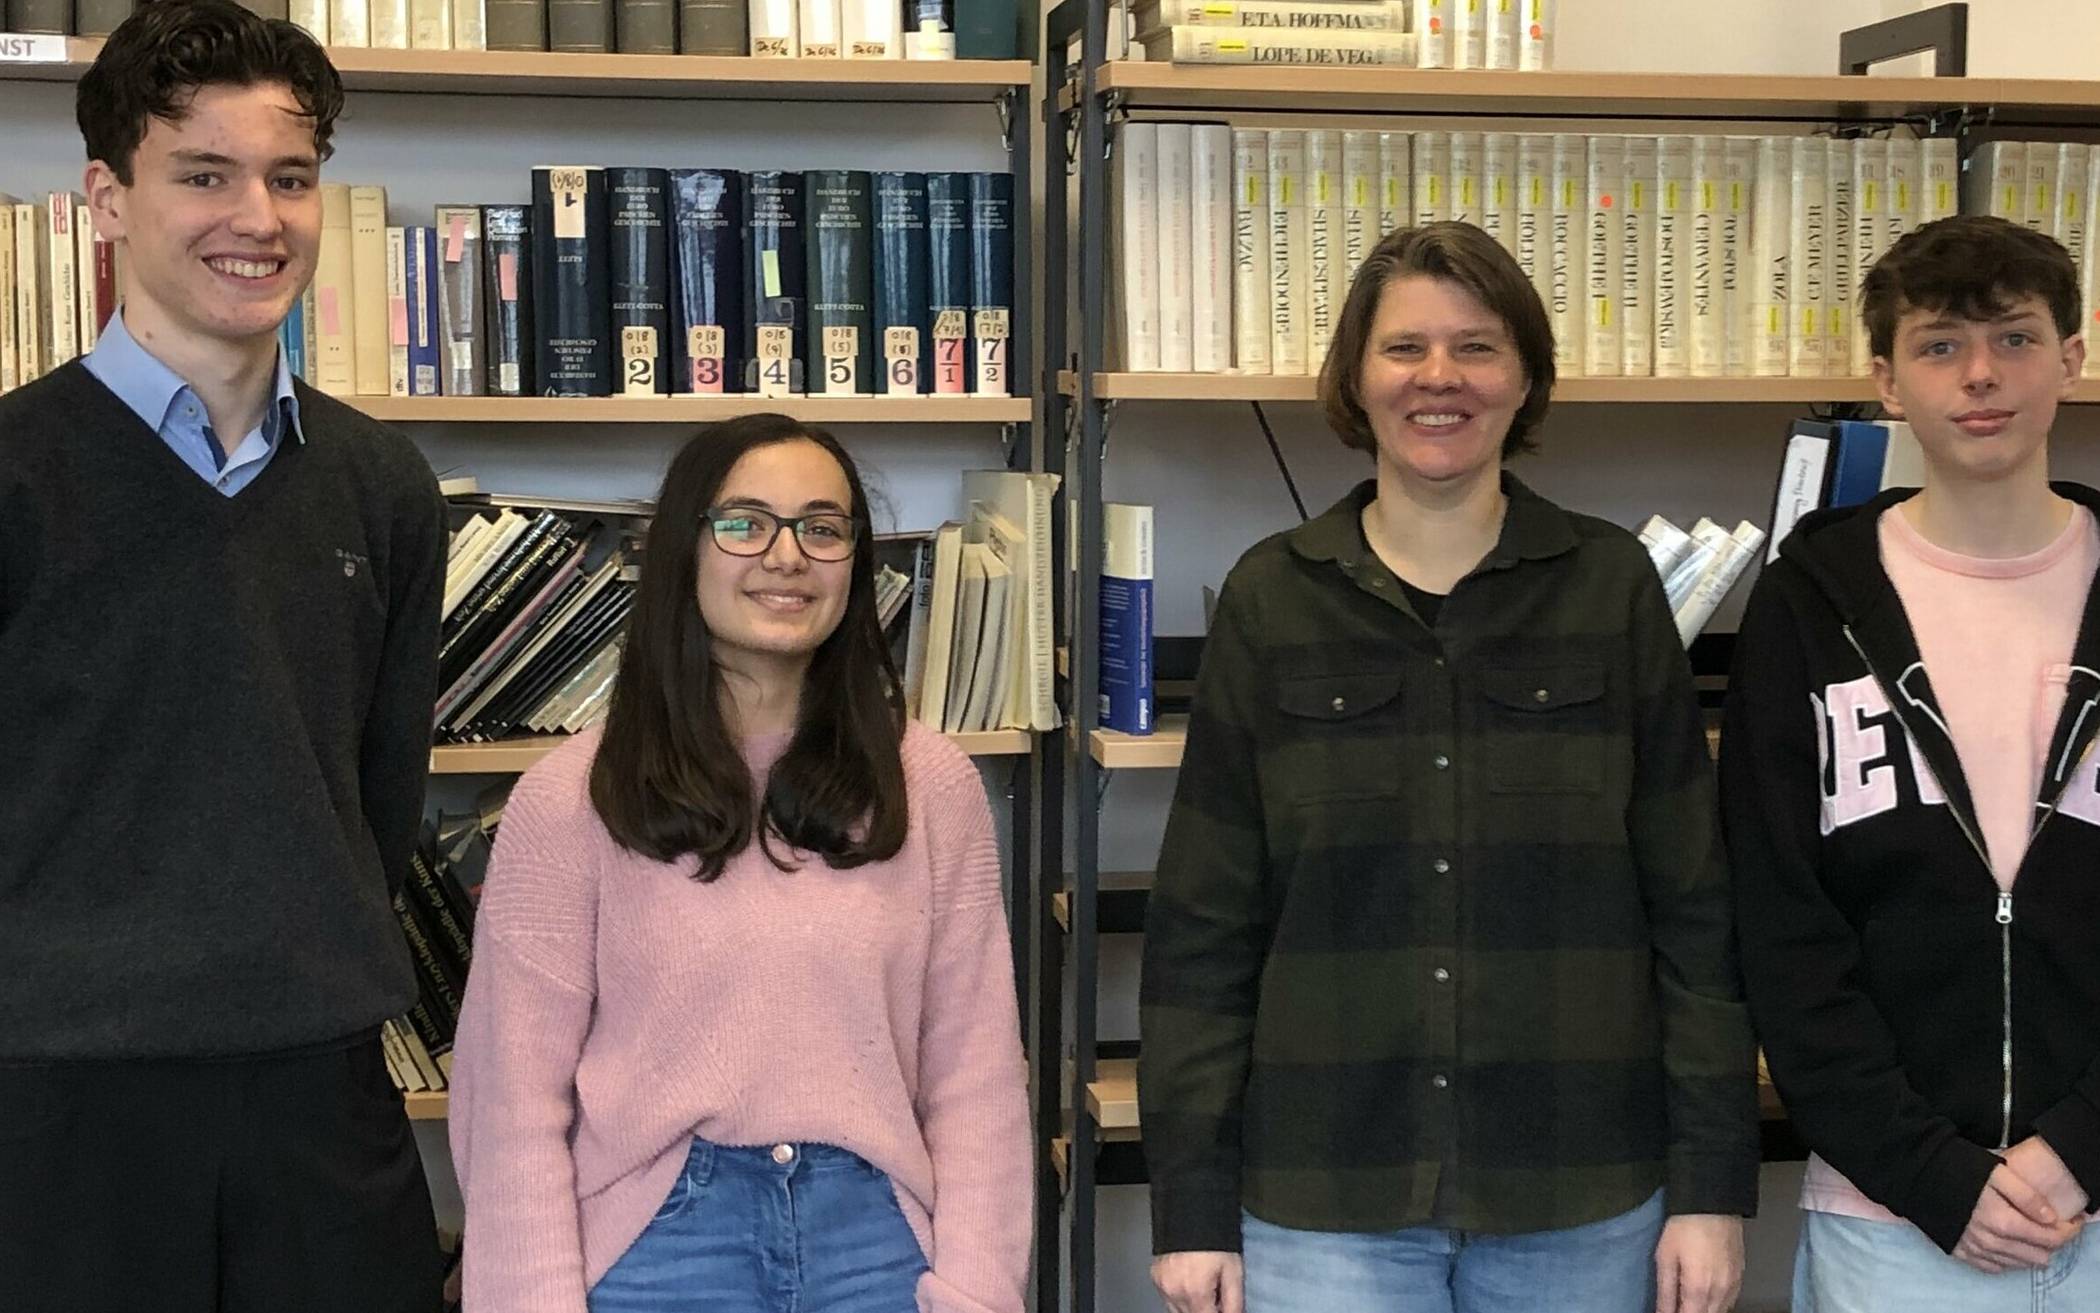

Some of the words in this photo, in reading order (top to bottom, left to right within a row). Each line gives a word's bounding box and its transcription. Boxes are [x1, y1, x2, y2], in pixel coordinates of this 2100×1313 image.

[1252, 46, 1302, 62] LOPE
[1306, 48, 1332, 63] DE
[1238, 210, 1253, 273] BALZAC
[1592, 212, 1607, 289] GOETHE
[1807, 204, 1823, 269] MEYER
[1836, 181, 1850, 302] GRILLPARZER
[1553, 214, 1569, 314] BOCCACCIO
[1624, 213, 1638, 290] GOETHE
[1694, 213, 1710, 316] CERVANTES
[1313, 209, 1329, 336] SHAKESPEARE
[1771, 255, 1788, 302] ZOLA
[939, 338, 960, 361] 7
[982, 338, 1002, 361] 7
[628, 358, 652, 385] 2
[697, 357, 719, 385] 3
[763, 359, 787, 385] 4
[830, 357, 852, 384] 5
[892, 358, 914, 386] 6
[945, 367, 955, 383] 1
[985, 367, 999, 382] 2
